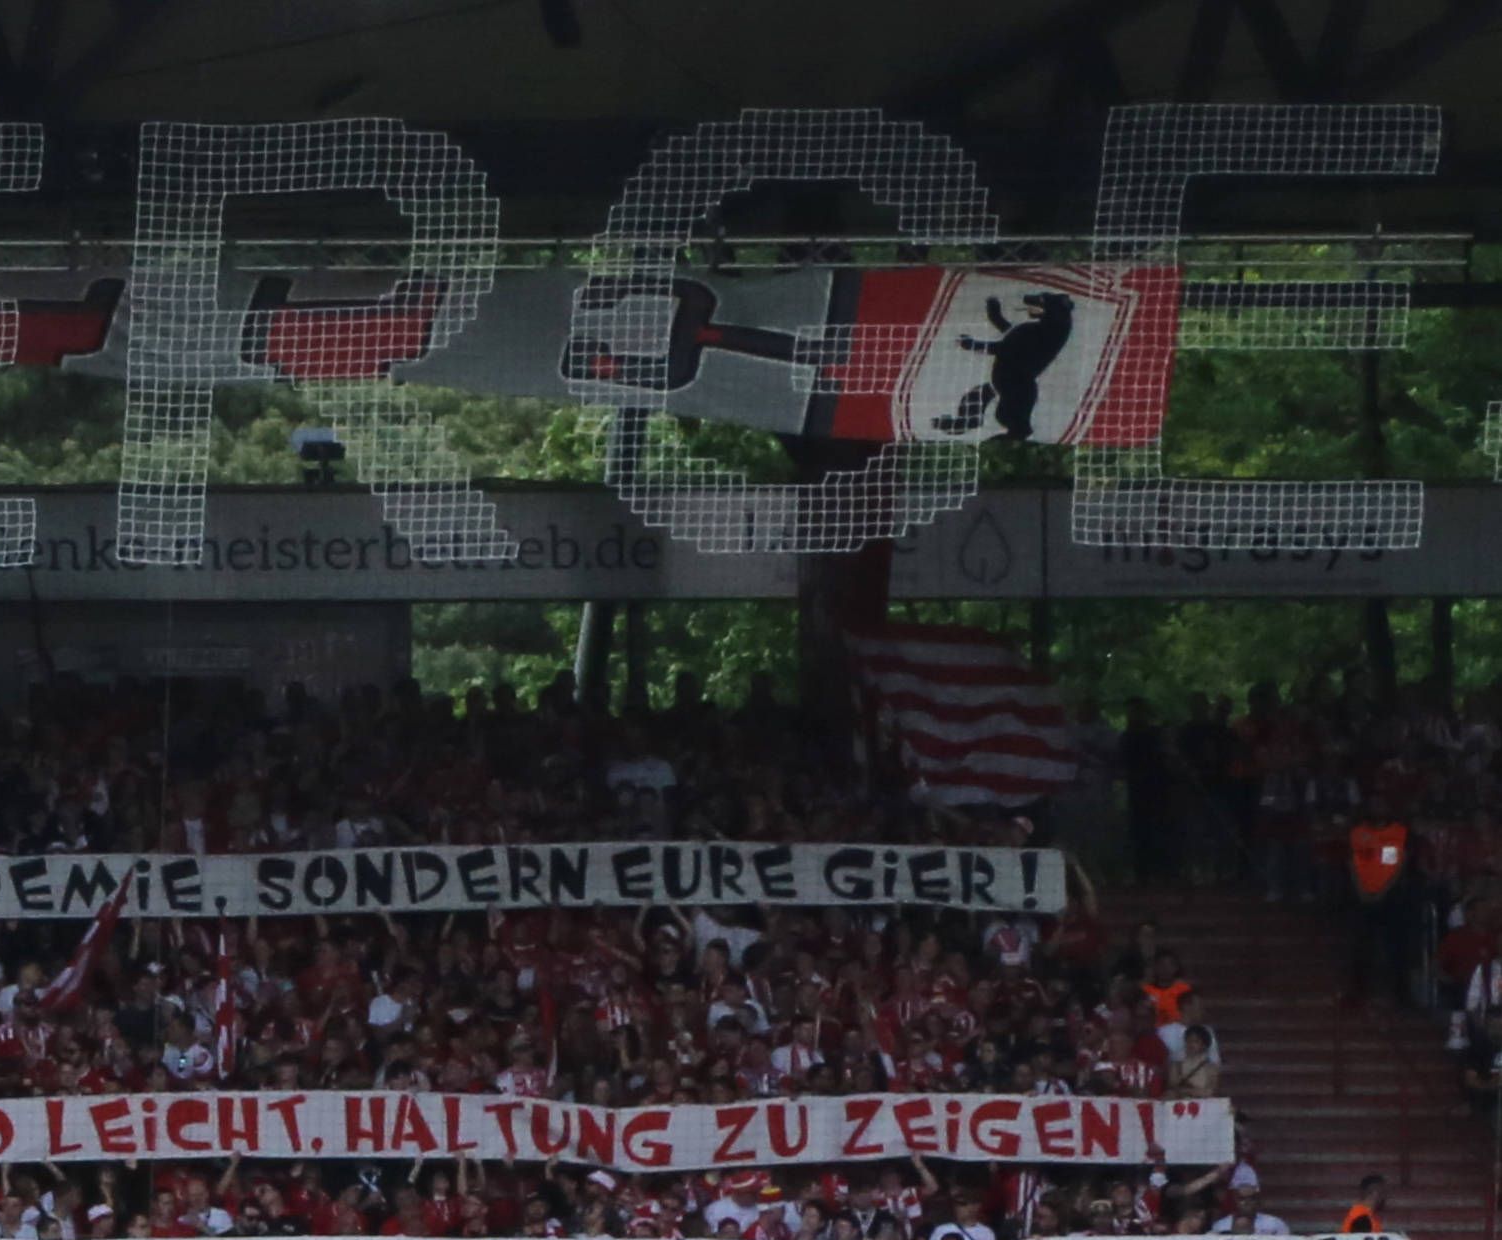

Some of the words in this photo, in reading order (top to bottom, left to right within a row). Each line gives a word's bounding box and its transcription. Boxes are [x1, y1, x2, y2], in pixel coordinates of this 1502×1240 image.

[256, 845, 591, 911] SONDERN
[611, 845, 795, 901] EURE
[344, 1094, 673, 1168] HALTUNG
[713, 1104, 809, 1163] ZU
